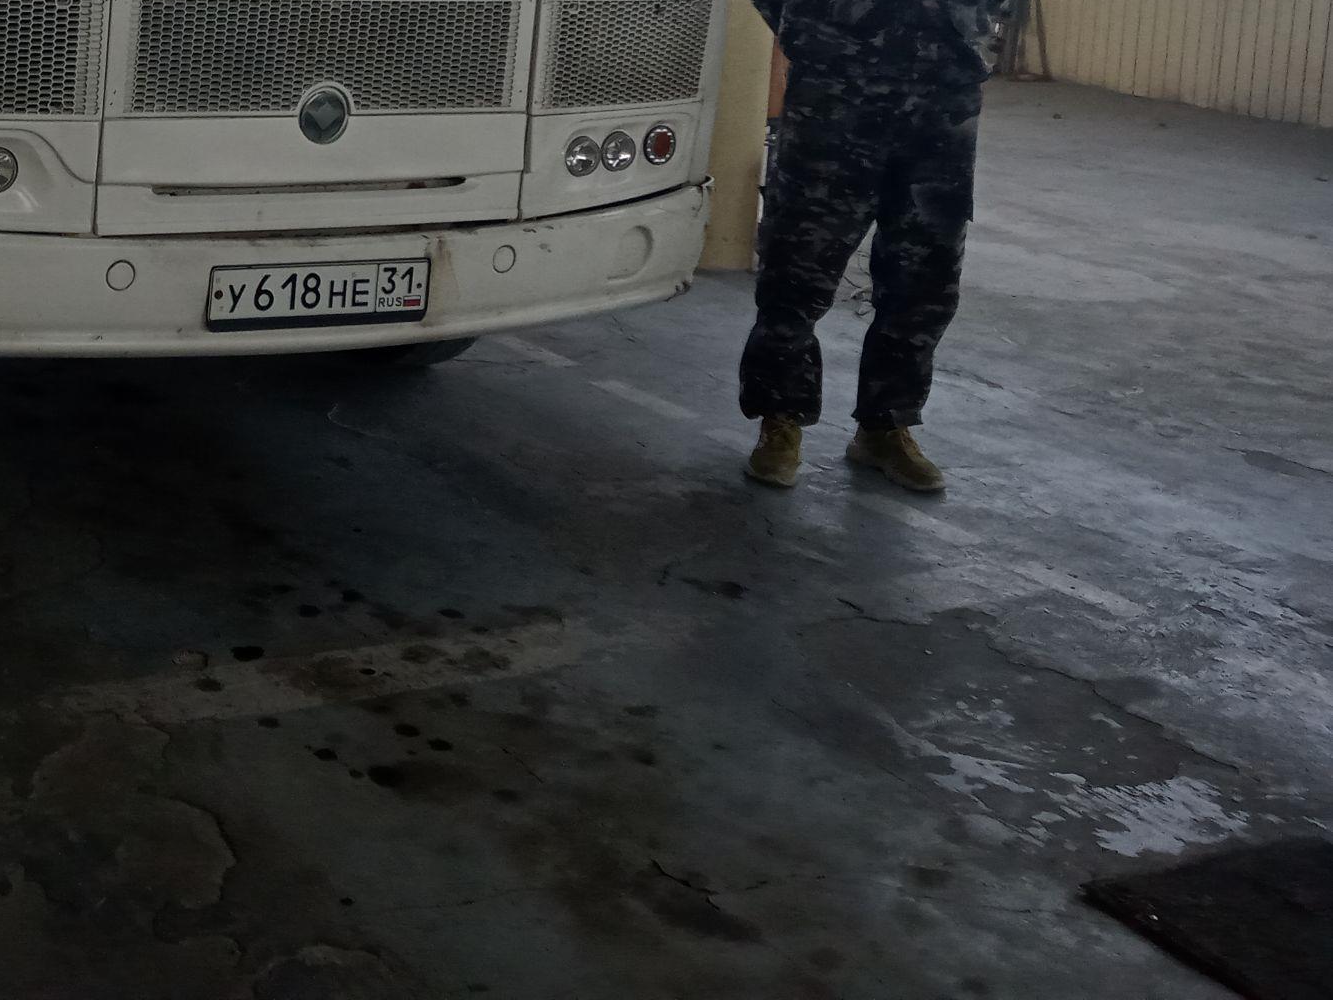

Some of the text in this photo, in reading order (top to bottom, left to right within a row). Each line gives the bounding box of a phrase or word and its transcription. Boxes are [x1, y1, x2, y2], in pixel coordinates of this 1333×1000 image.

[228, 266, 415, 313] У618НЕ 31
[378, 296, 403, 308] RUS
